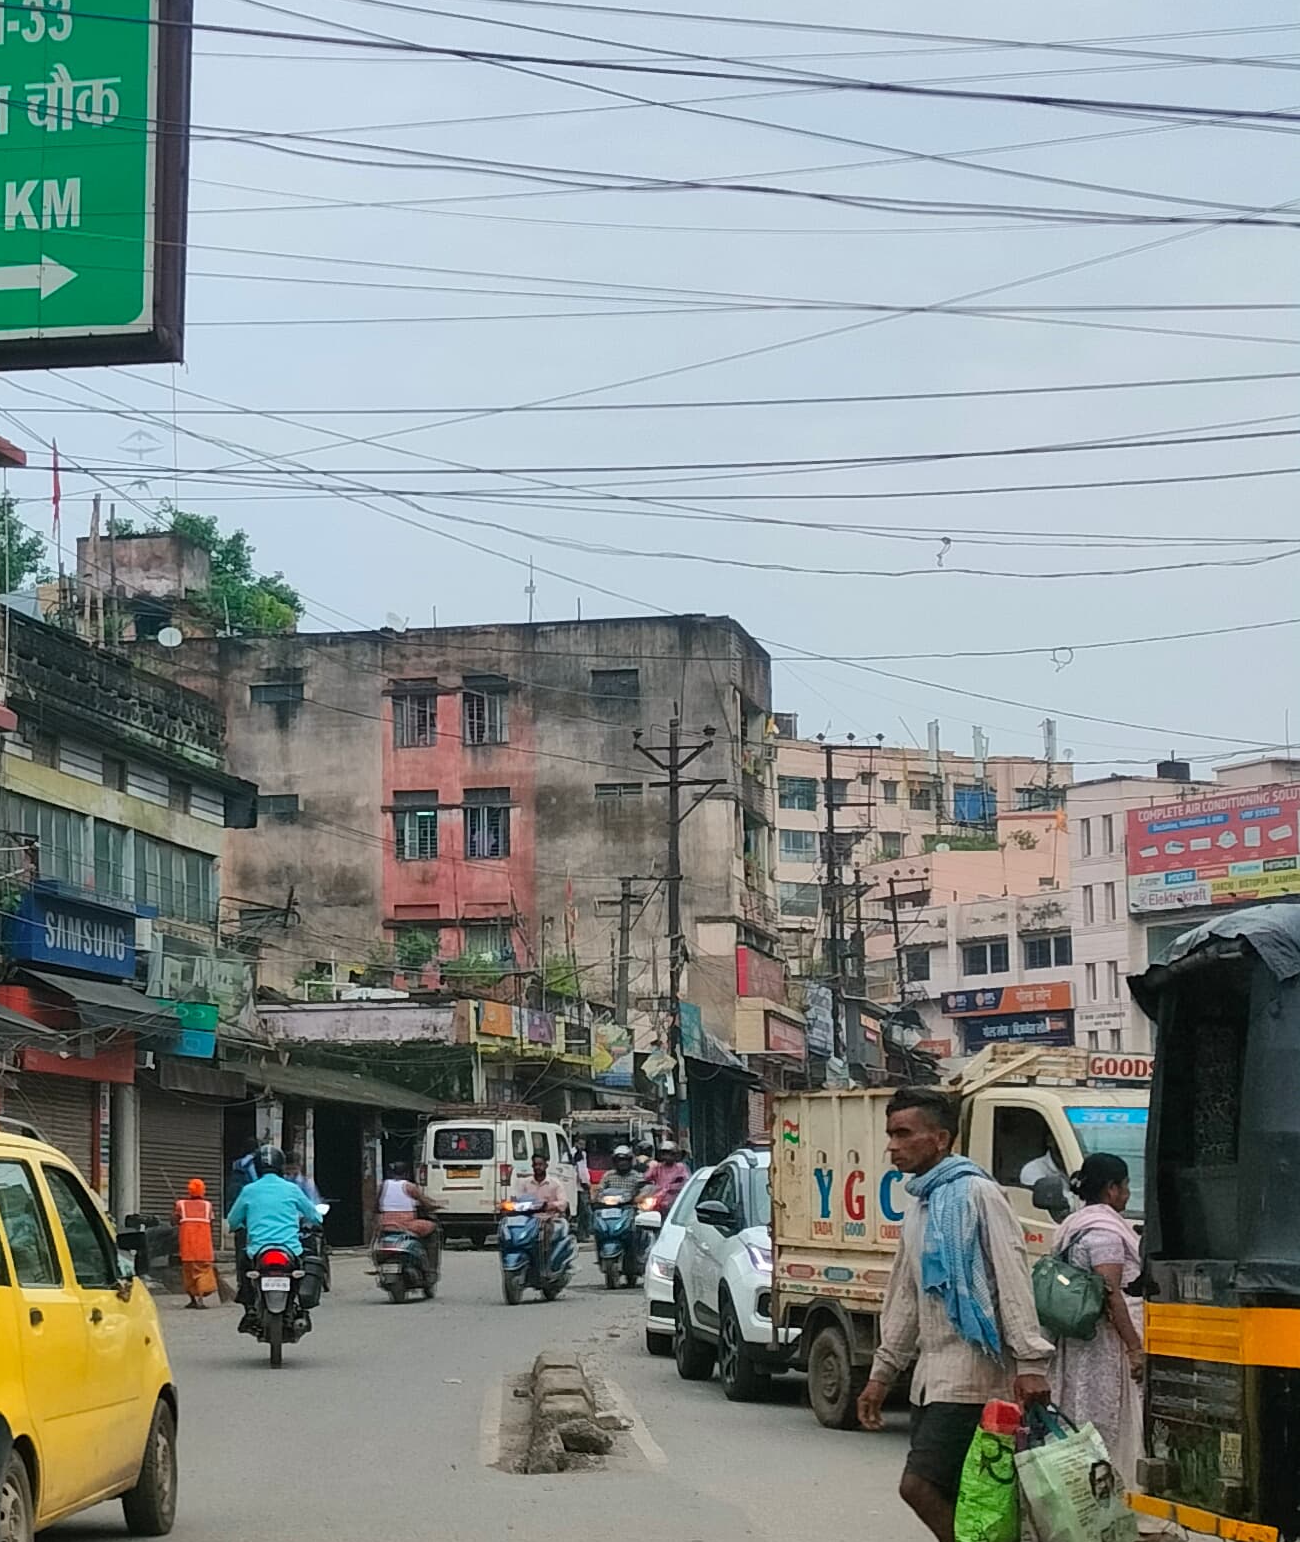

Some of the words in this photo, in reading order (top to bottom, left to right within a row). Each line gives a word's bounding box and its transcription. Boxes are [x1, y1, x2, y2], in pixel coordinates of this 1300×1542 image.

[27, 63, 119, 129] चौक
[4, 178, 81, 230] KM
[1137, 805, 1184, 823] COMPLETE
[1185, 802, 1201, 816] AIR
[1201, 791, 1270, 813] CONDITIONING
[1272, 787, 1300, 802] SOLU
[44, 911, 127, 961] SAMSUNG
[813, 1167, 833, 1219] Y
[843, 1169, 866, 1221] G
[879, 1169, 905, 1222] C
